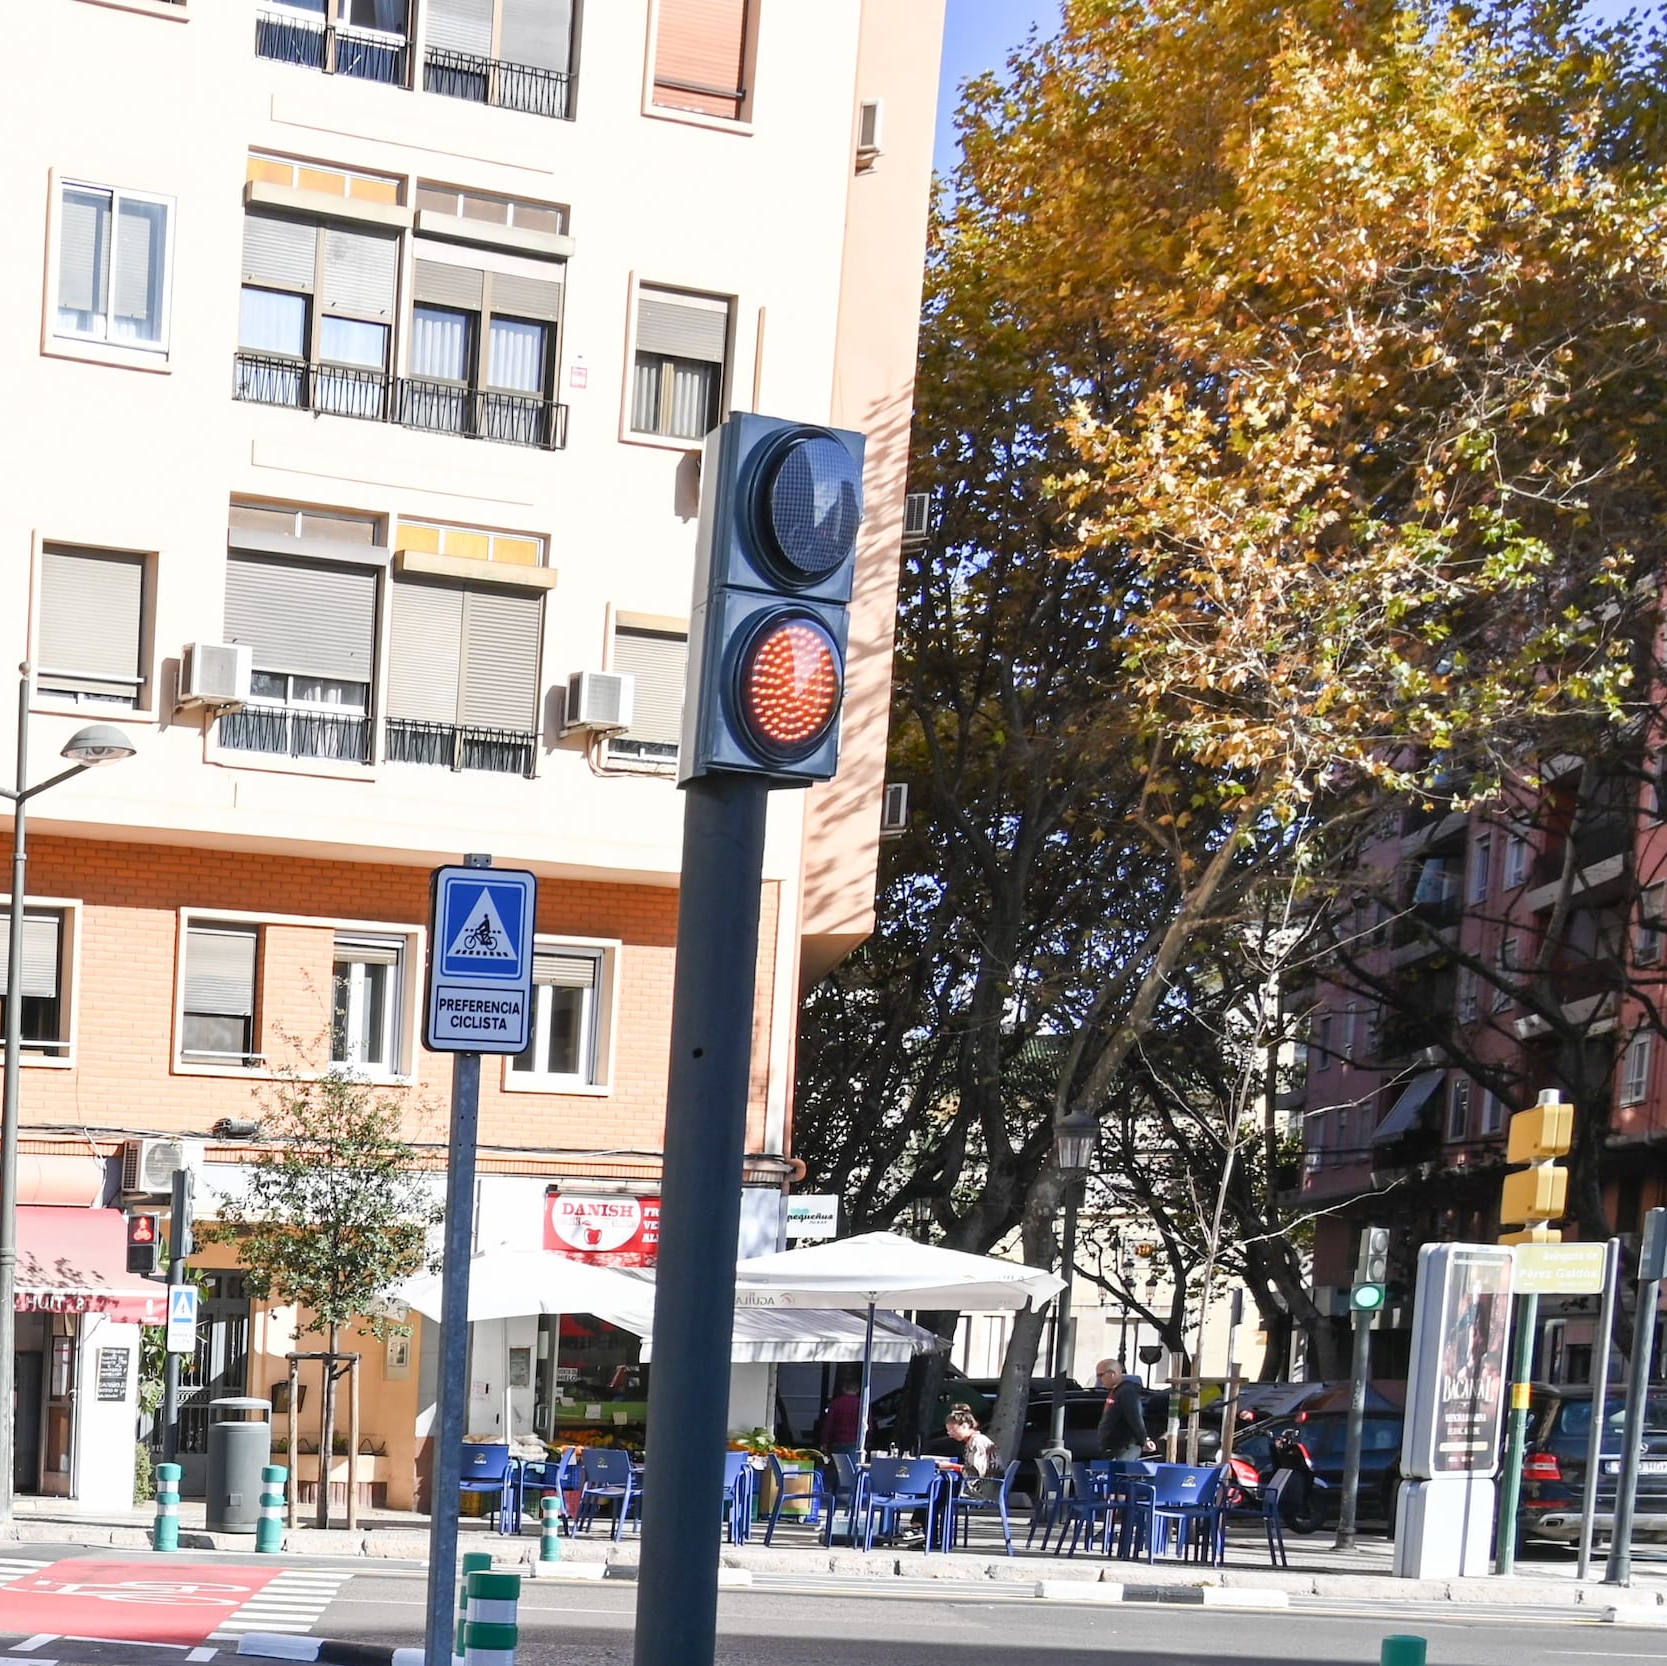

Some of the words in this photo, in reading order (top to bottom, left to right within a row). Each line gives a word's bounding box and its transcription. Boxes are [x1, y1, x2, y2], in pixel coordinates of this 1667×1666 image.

[439, 998, 520, 1015] PREFERENCIA
[450, 1015, 507, 1031] CICLISTA
[562, 1203, 634, 1217] DANISH
[26, 1294, 66, 1312] HUIT
[1442, 1375, 1494, 1402] BACANAL
